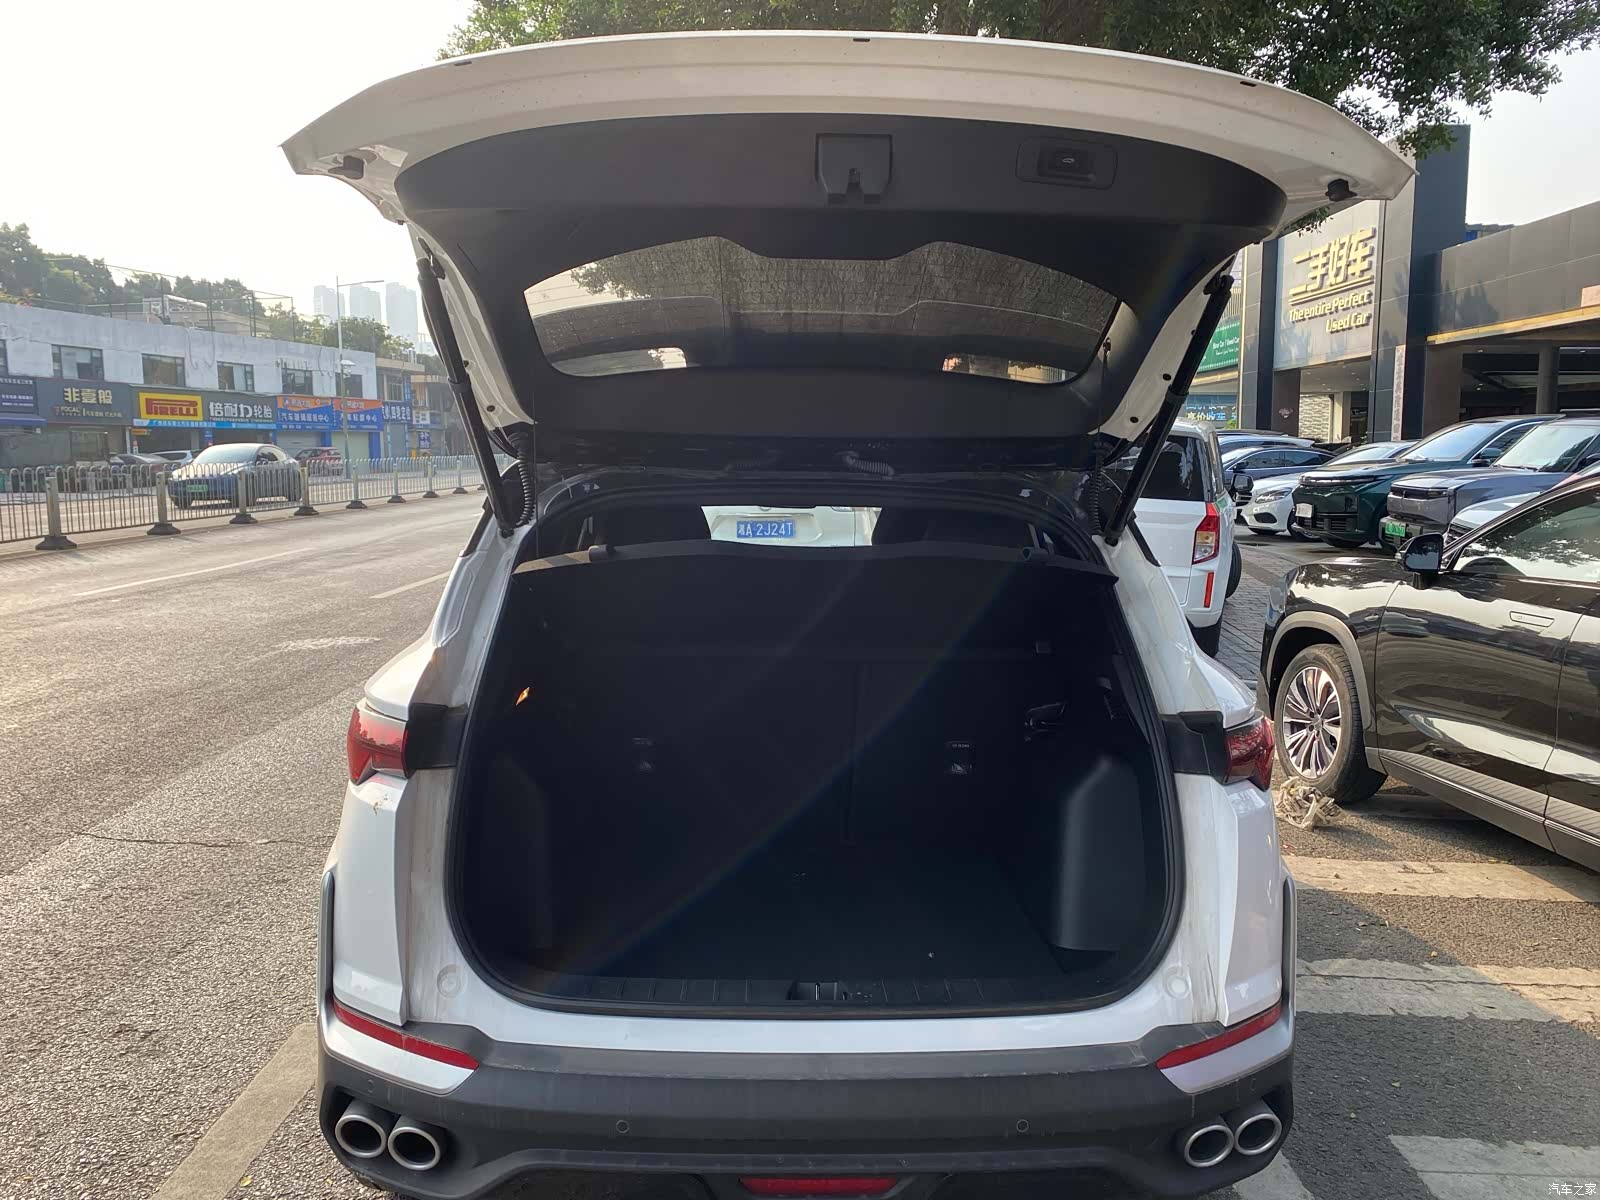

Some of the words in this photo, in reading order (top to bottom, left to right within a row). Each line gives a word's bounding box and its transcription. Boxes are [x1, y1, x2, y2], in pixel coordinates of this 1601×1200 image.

[1288, 227, 1375, 296] 二手好车
[1331, 290, 1369, 312] Perfect
[1325, 314, 1350, 333] Used
[1350, 312, 1369, 327] Car
[145, 398, 198, 417] PIRELLI
[209, 401, 273, 419] 倍耐力轮胎
